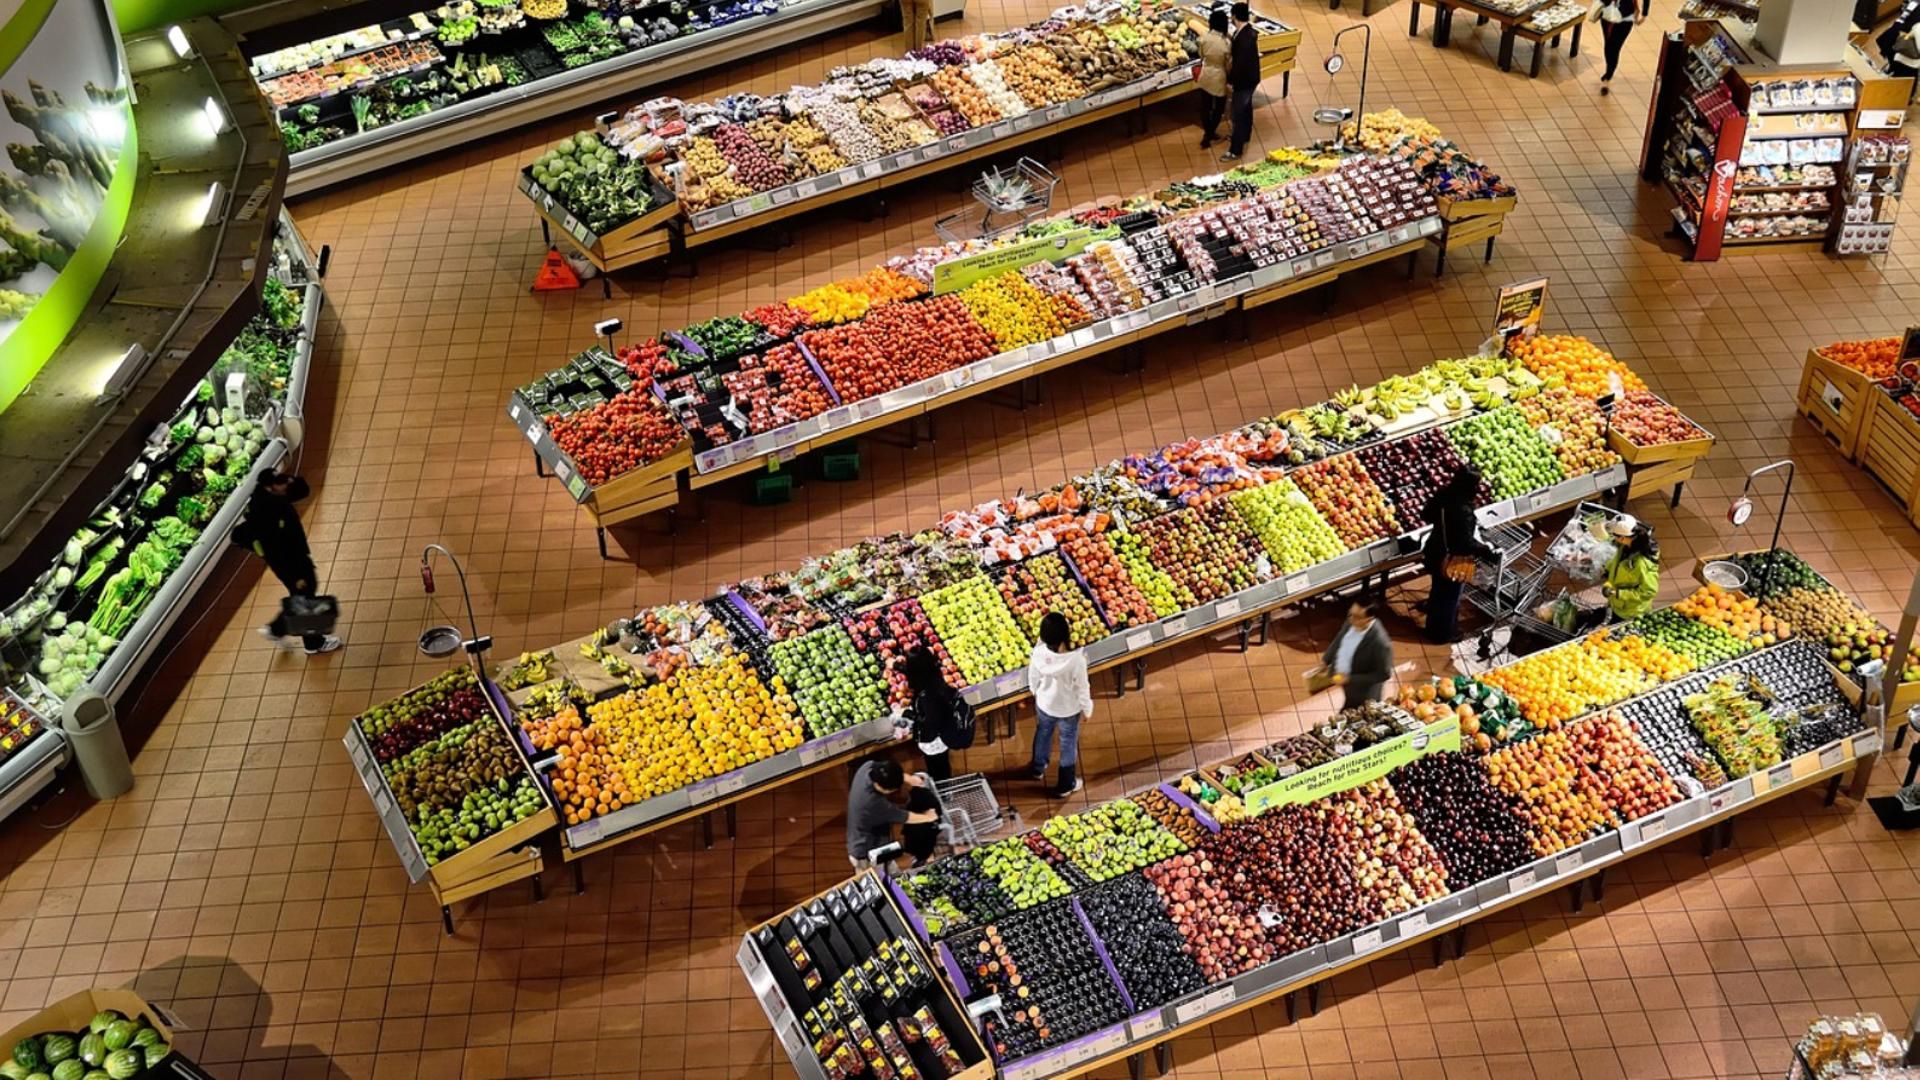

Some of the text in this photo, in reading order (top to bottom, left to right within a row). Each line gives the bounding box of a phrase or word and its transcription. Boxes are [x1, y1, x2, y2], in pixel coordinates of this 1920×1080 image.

[961, 257, 985, 268] Looking
[987, 254, 996, 262] for
[997, 247, 1025, 259] nutritious
[1026, 240, 1051, 252] choices?
[978, 260, 996, 269] Reach
[997, 258, 1006, 267] for
[1007, 254, 1016, 263] the
[1285, 775, 1317, 792] Looking
[1319, 769, 1330, 780] for
[1332, 754, 1371, 774] nutritious
[1373, 740, 1407, 760] choices?
[1306, 756, 1386, 792] Reach for the Stars!
